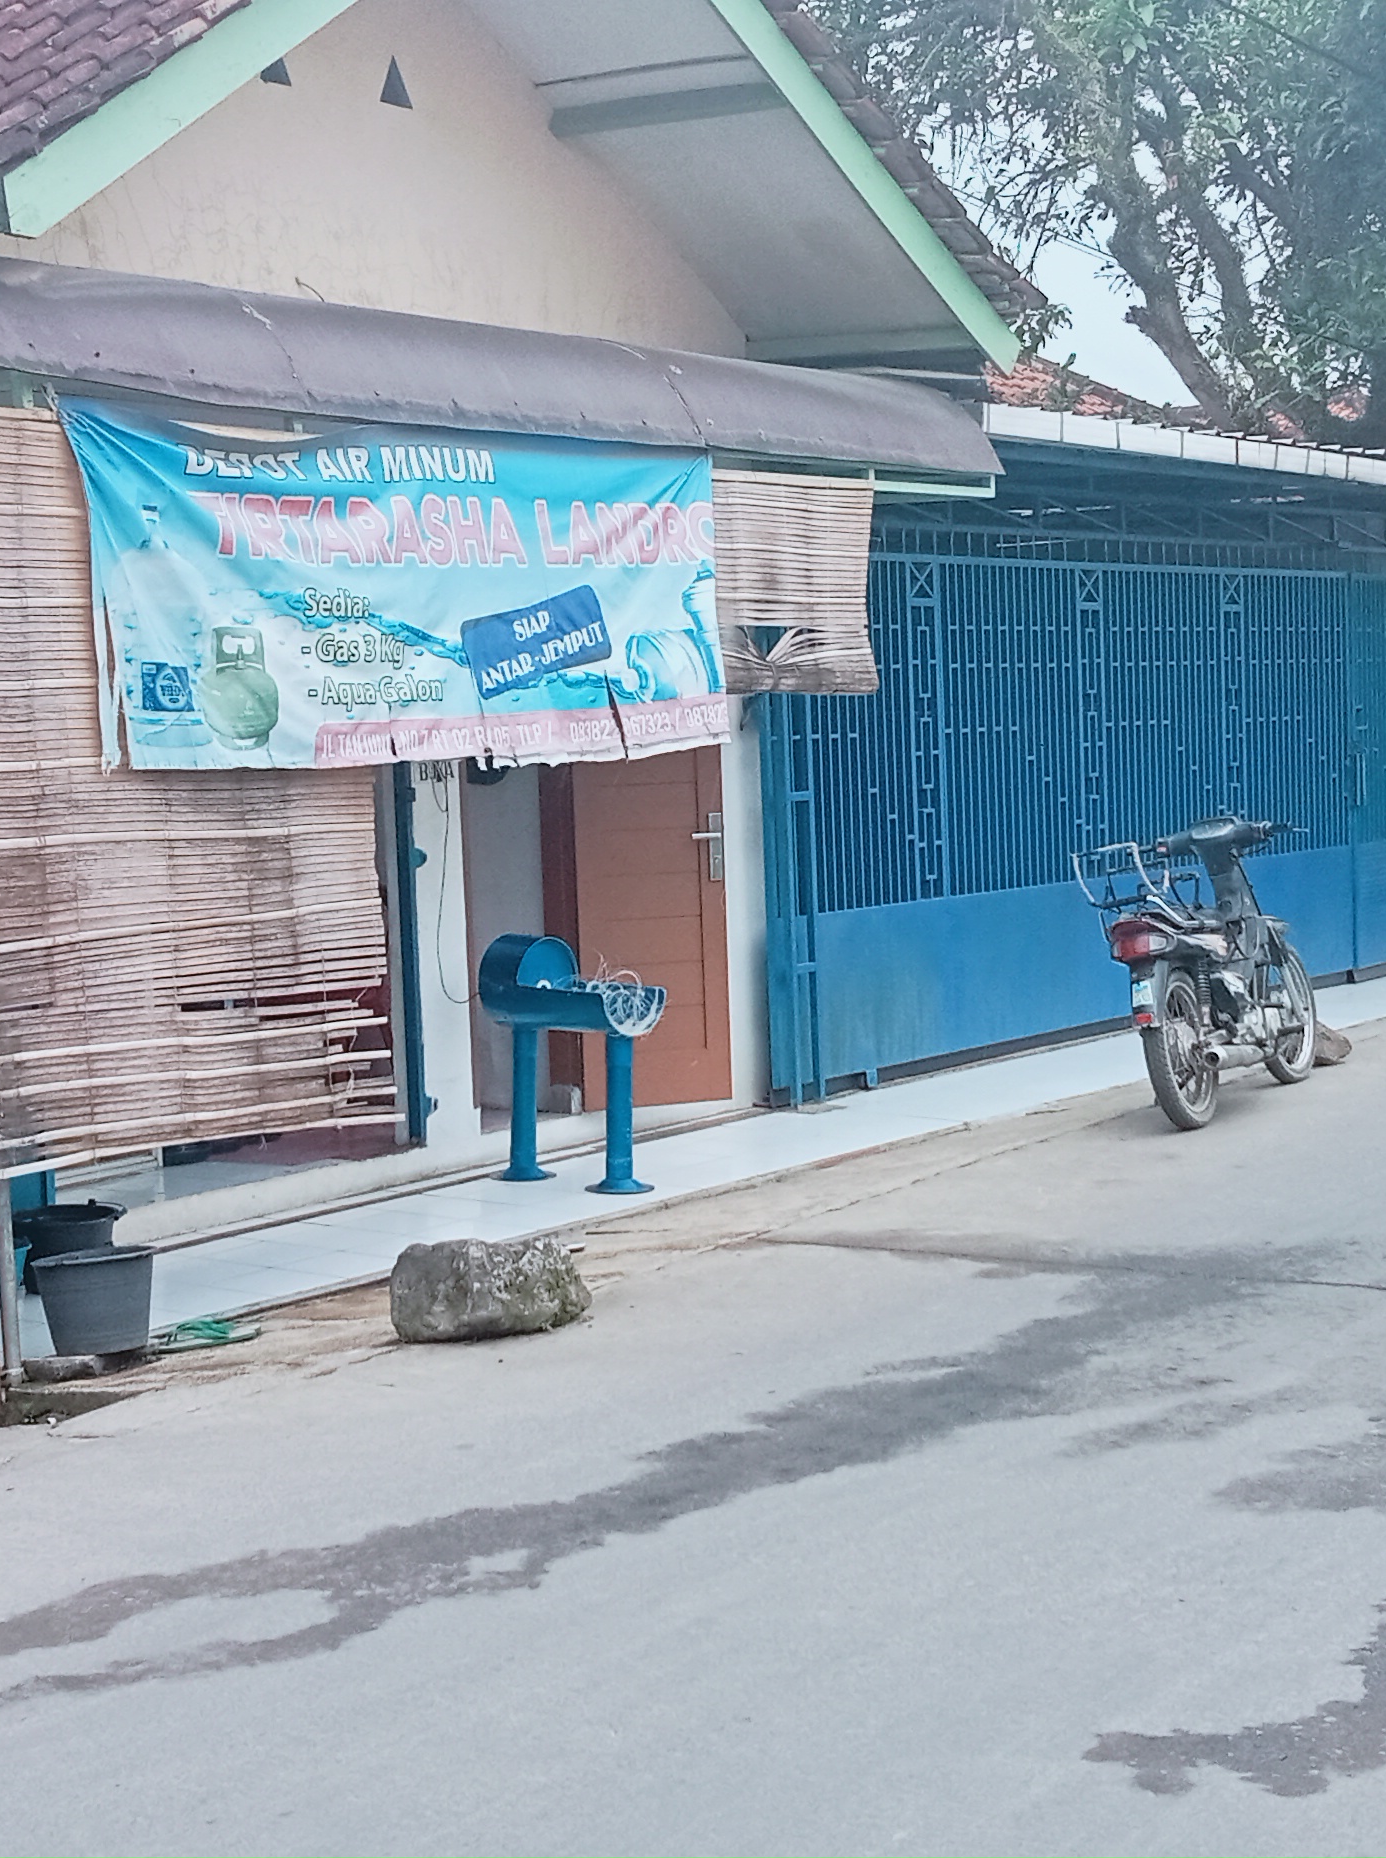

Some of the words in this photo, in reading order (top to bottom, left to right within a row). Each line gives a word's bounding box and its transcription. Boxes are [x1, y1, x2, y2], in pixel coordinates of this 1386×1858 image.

[178, 444, 307, 481] DEPOT
[316, 446, 373, 483] AIR
[379, 444, 495, 484] MINUM
[186, 490, 528, 568] TIRTARASHA
[303, 587, 370, 618] Sedia:
[513, 610, 550, 642] SIAP
[316, 633, 360, 663] Gas
[364, 633, 377, 662] 3
[379, 633, 405, 669] Kg
[321, 676, 377, 712] Aqua
[379, 674, 443, 705] Galon
[431, 728, 450, 752] RT
[452, 727, 473, 750] 02
[516, 723, 542, 746] TLP
